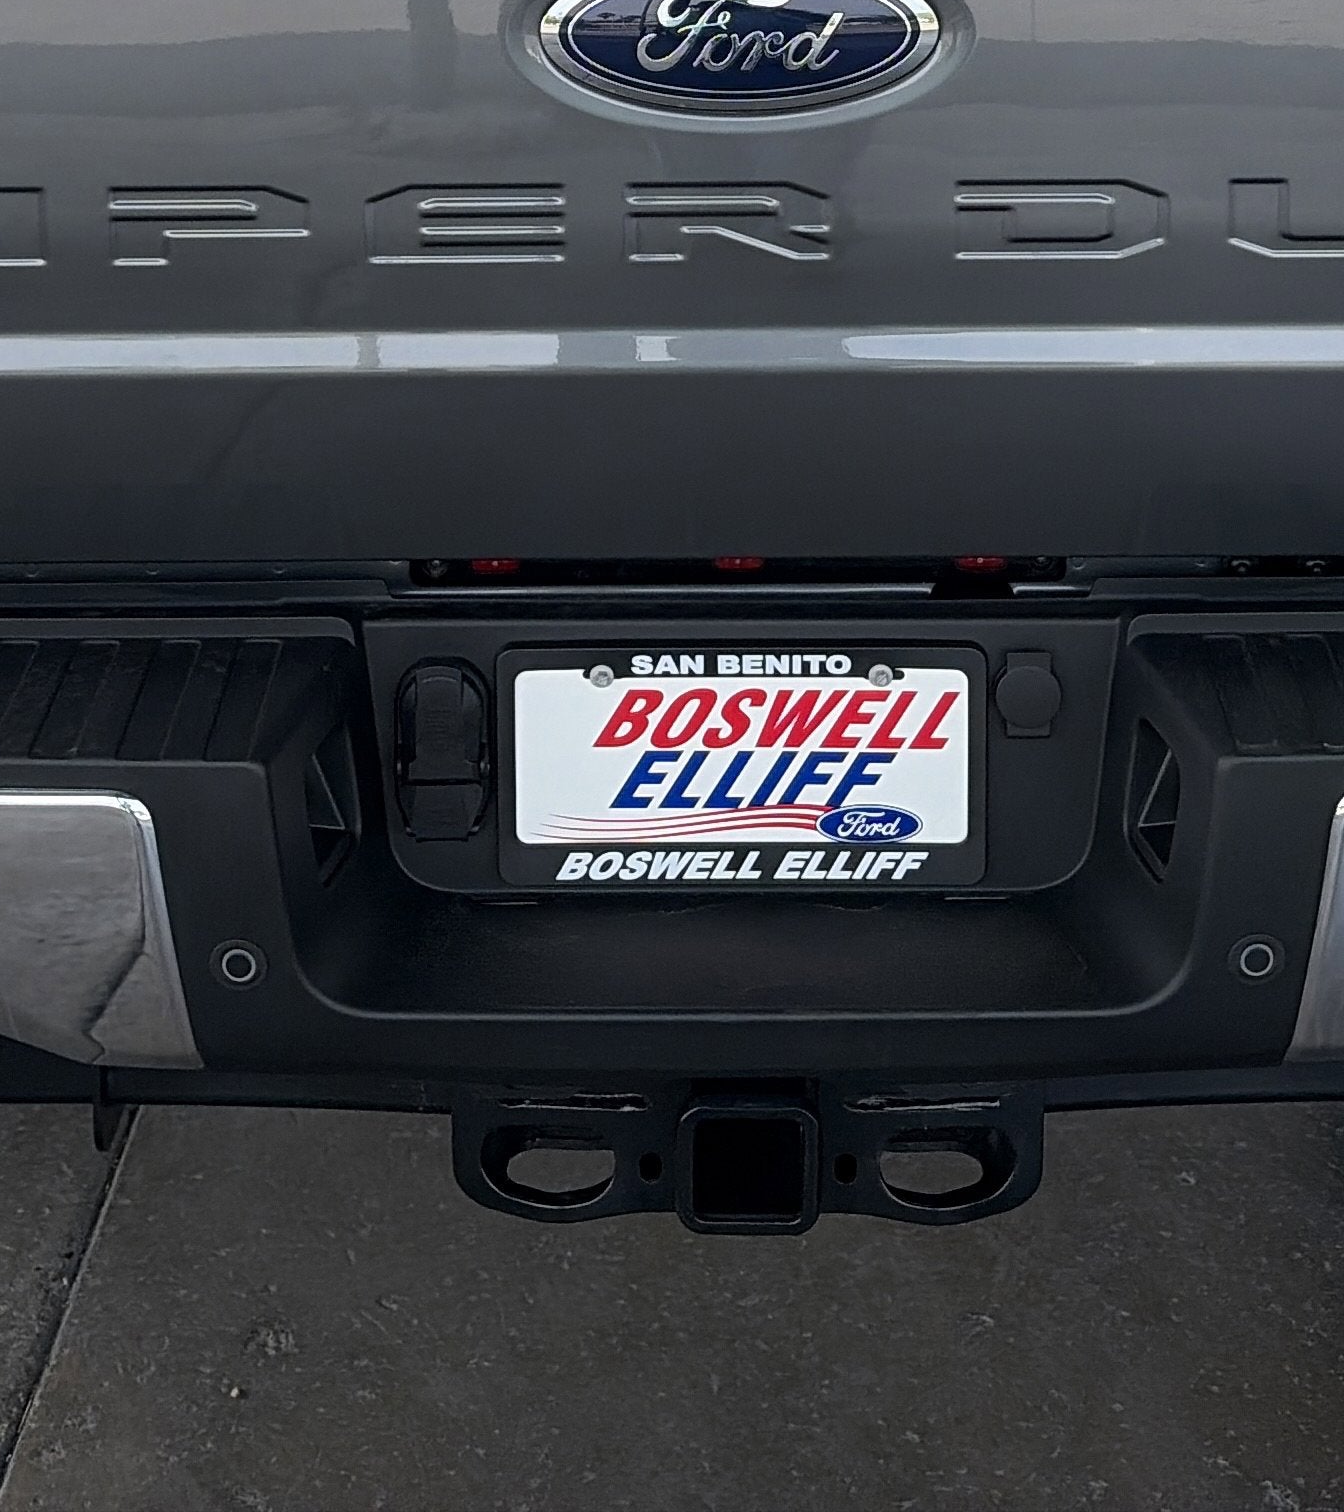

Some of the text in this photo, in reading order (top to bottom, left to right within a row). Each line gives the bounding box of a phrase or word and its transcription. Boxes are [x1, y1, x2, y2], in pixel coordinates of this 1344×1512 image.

[630, 654, 852, 676] SAN BENITO
[592, 688, 961, 750] BOSWELL
[608, 750, 898, 809] ELLIFF
[836, 810, 902, 839] Ford
[555, 850, 930, 881] BOSWELL ELLIFF
